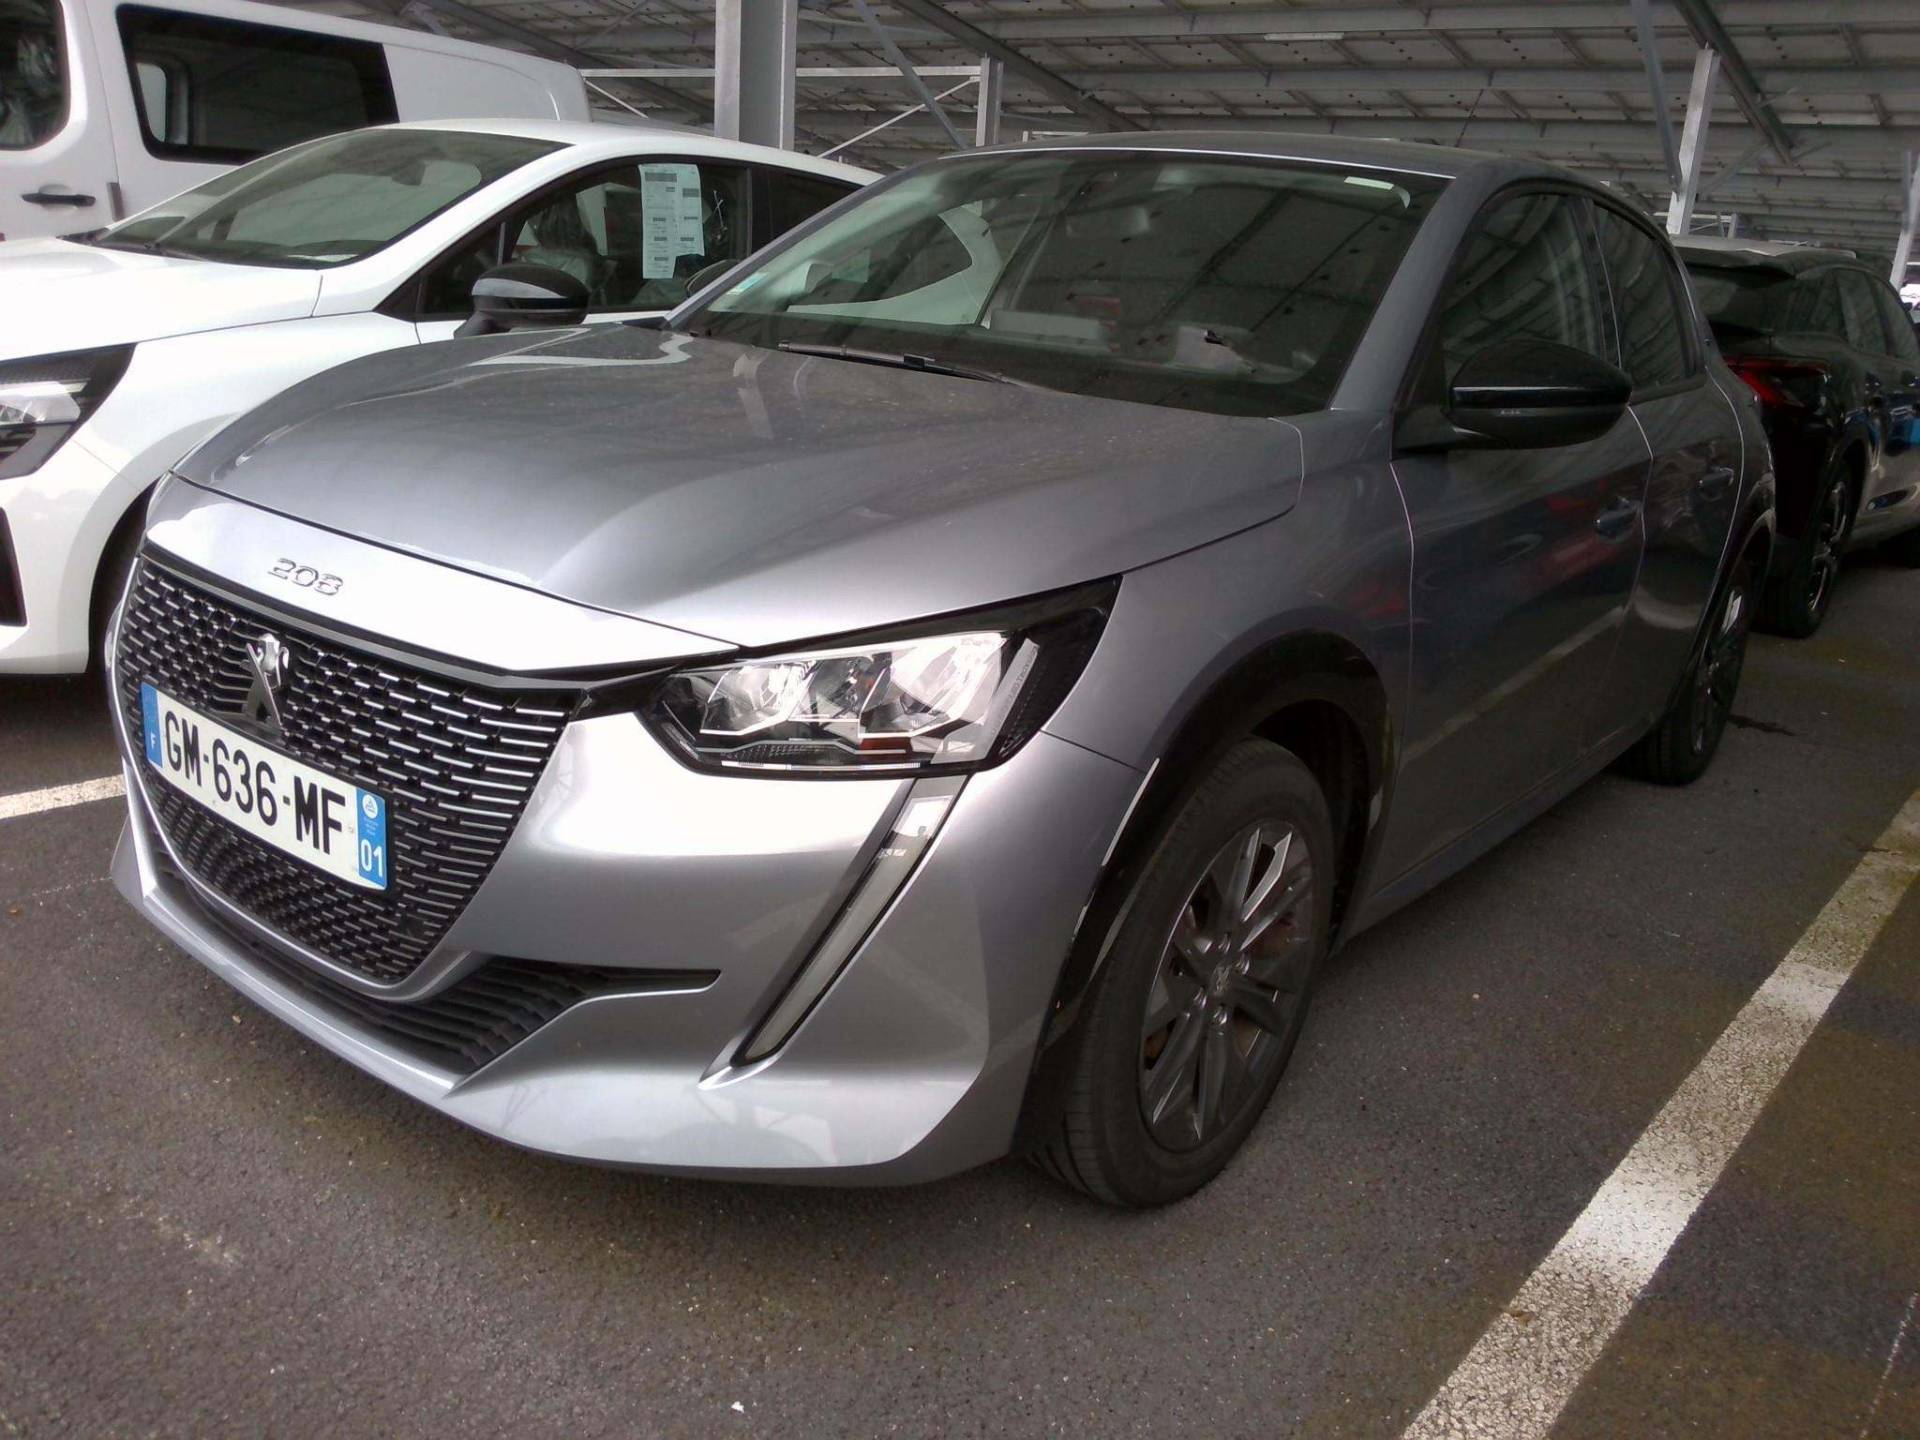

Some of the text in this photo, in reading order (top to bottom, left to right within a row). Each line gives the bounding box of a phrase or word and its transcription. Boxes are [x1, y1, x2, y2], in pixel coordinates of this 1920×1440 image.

[267, 558, 343, 595] 208
[150, 733, 157, 749] F
[164, 710, 346, 855] GM-636-MF
[360, 838, 383, 878] 01
